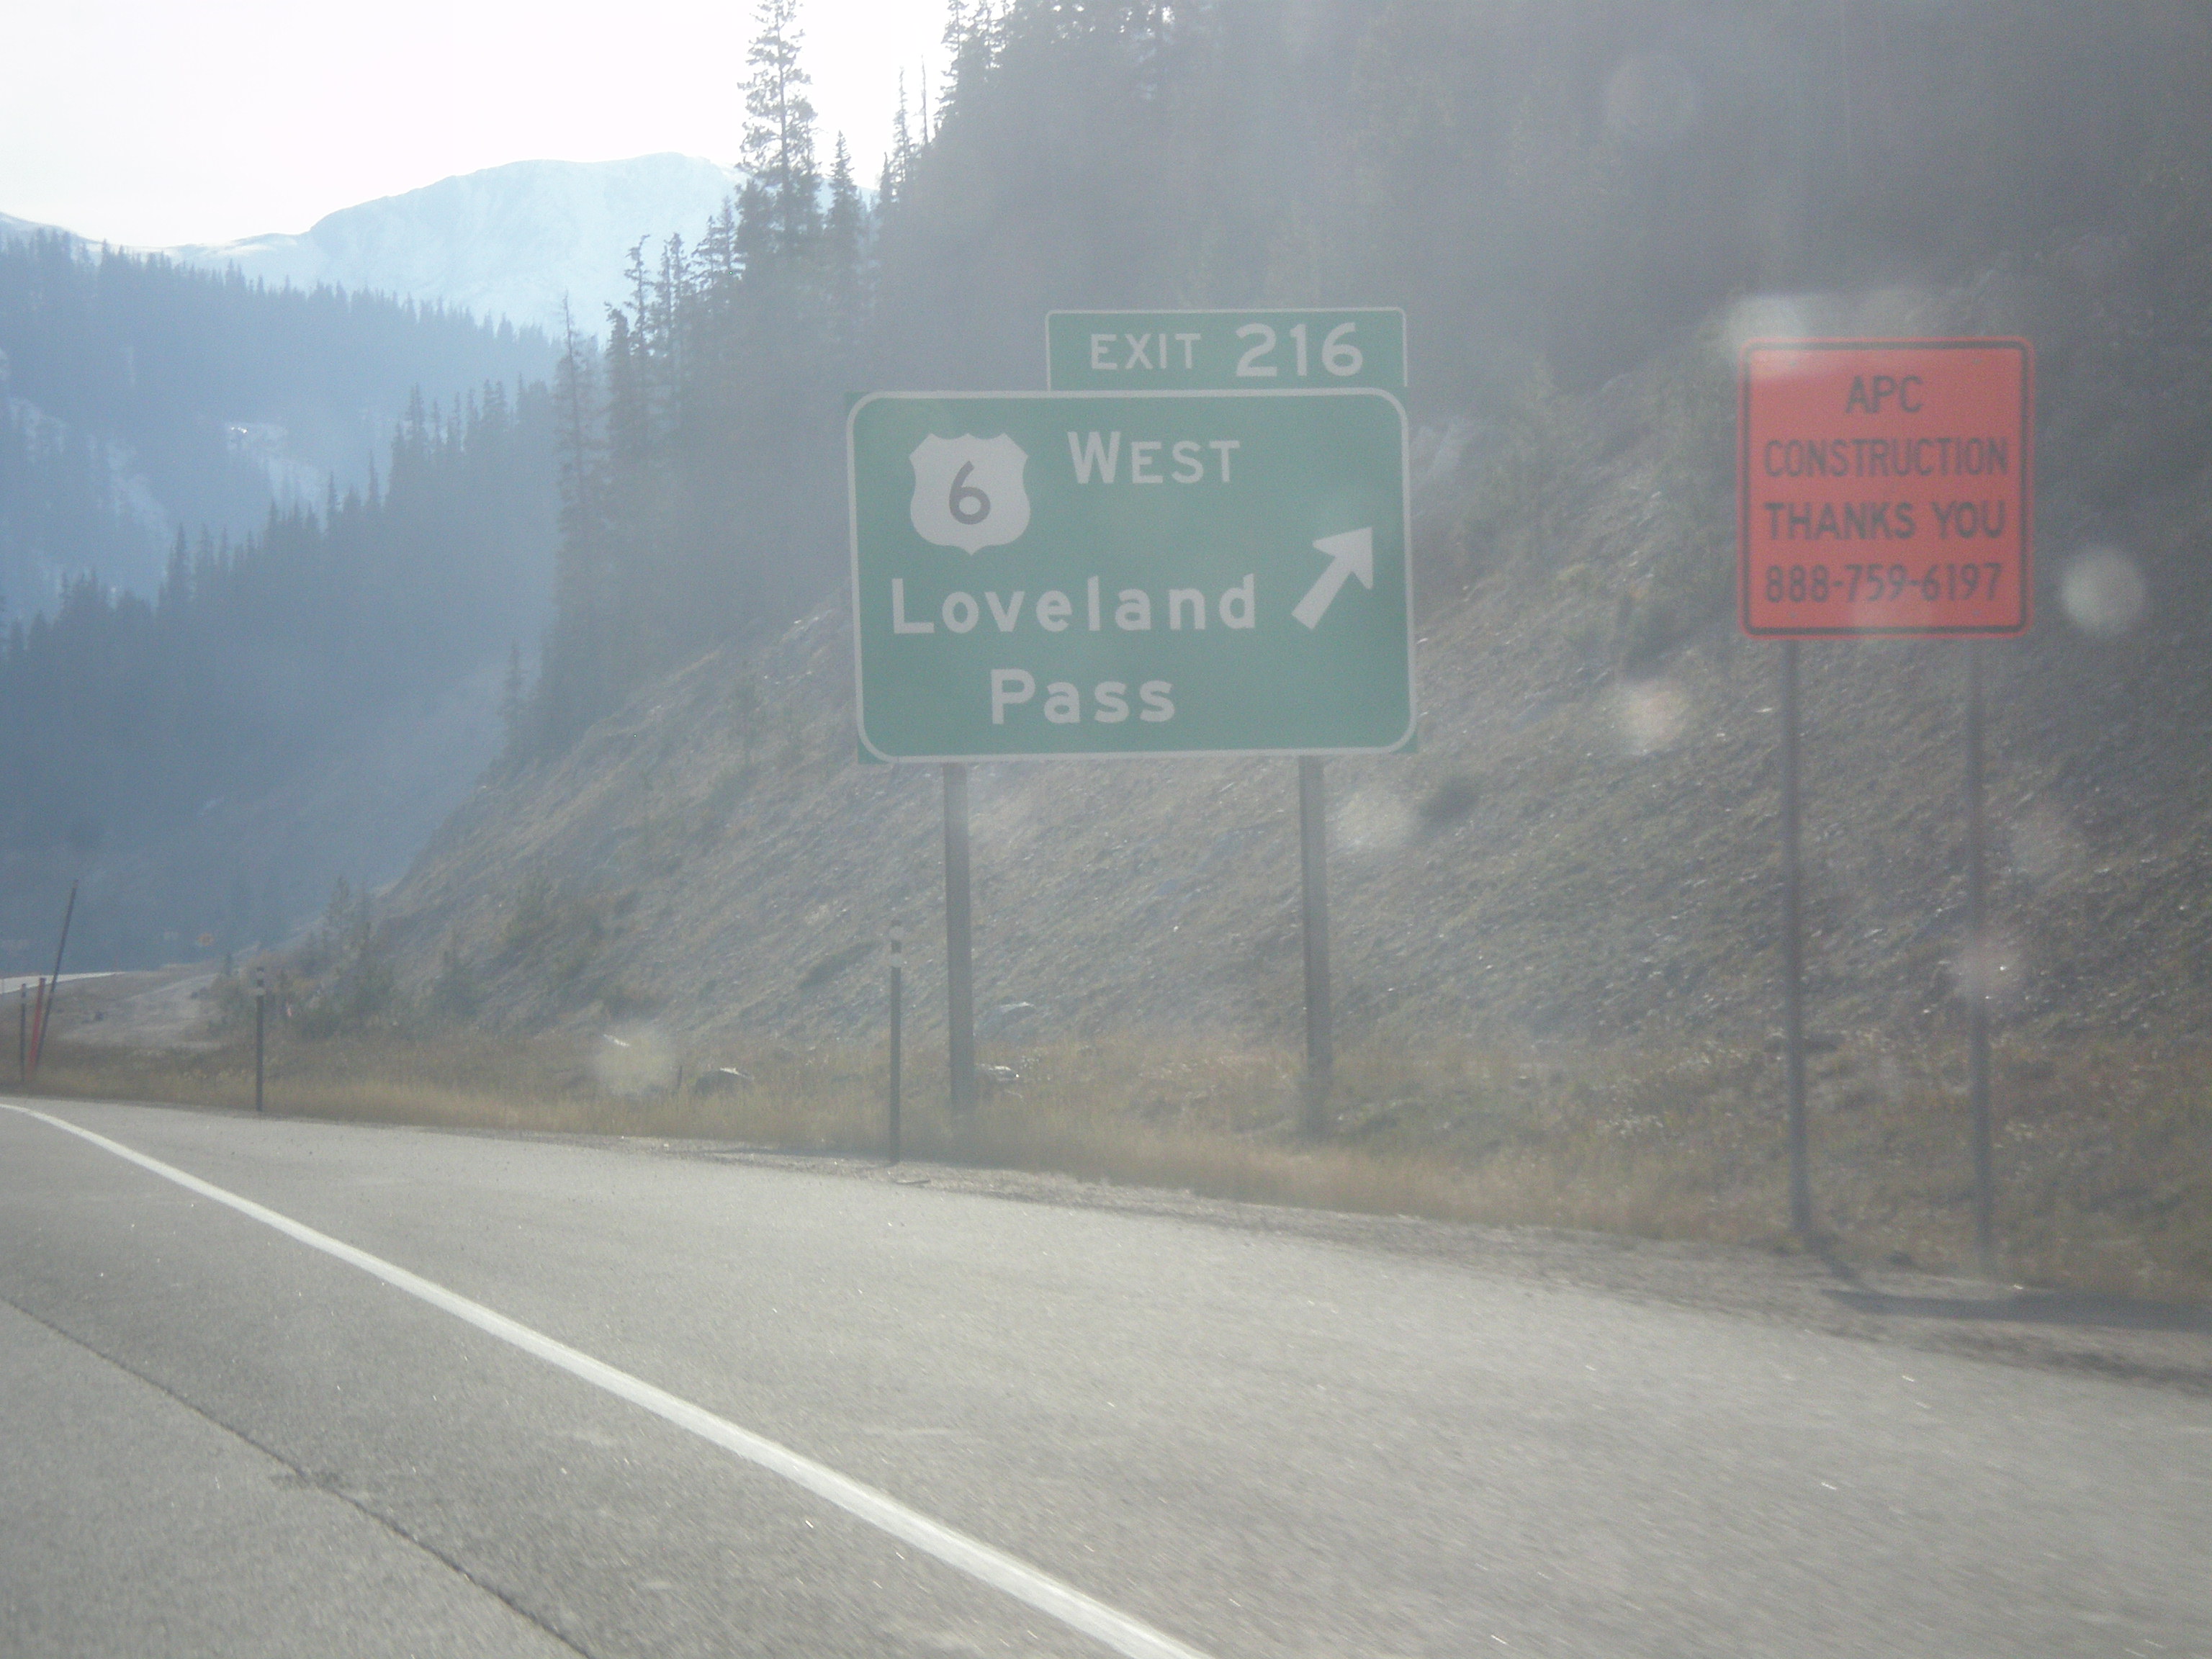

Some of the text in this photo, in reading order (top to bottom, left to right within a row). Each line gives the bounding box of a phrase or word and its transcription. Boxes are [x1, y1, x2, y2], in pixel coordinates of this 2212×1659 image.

[1090, 323, 1363, 377] EXIT 216
[1845, 375, 1924, 414] APC
[1067, 431, 1241, 485] WEST
[1764, 437, 2008, 477] CONSTRUCTION
[948, 460, 991, 525] 6
[1764, 500, 2005, 541] THANKS YOU
[891, 572, 1255, 634] Loveland
[1765, 562, 2002, 603] 888-759-6197
[990, 668, 1176, 724] Pass
